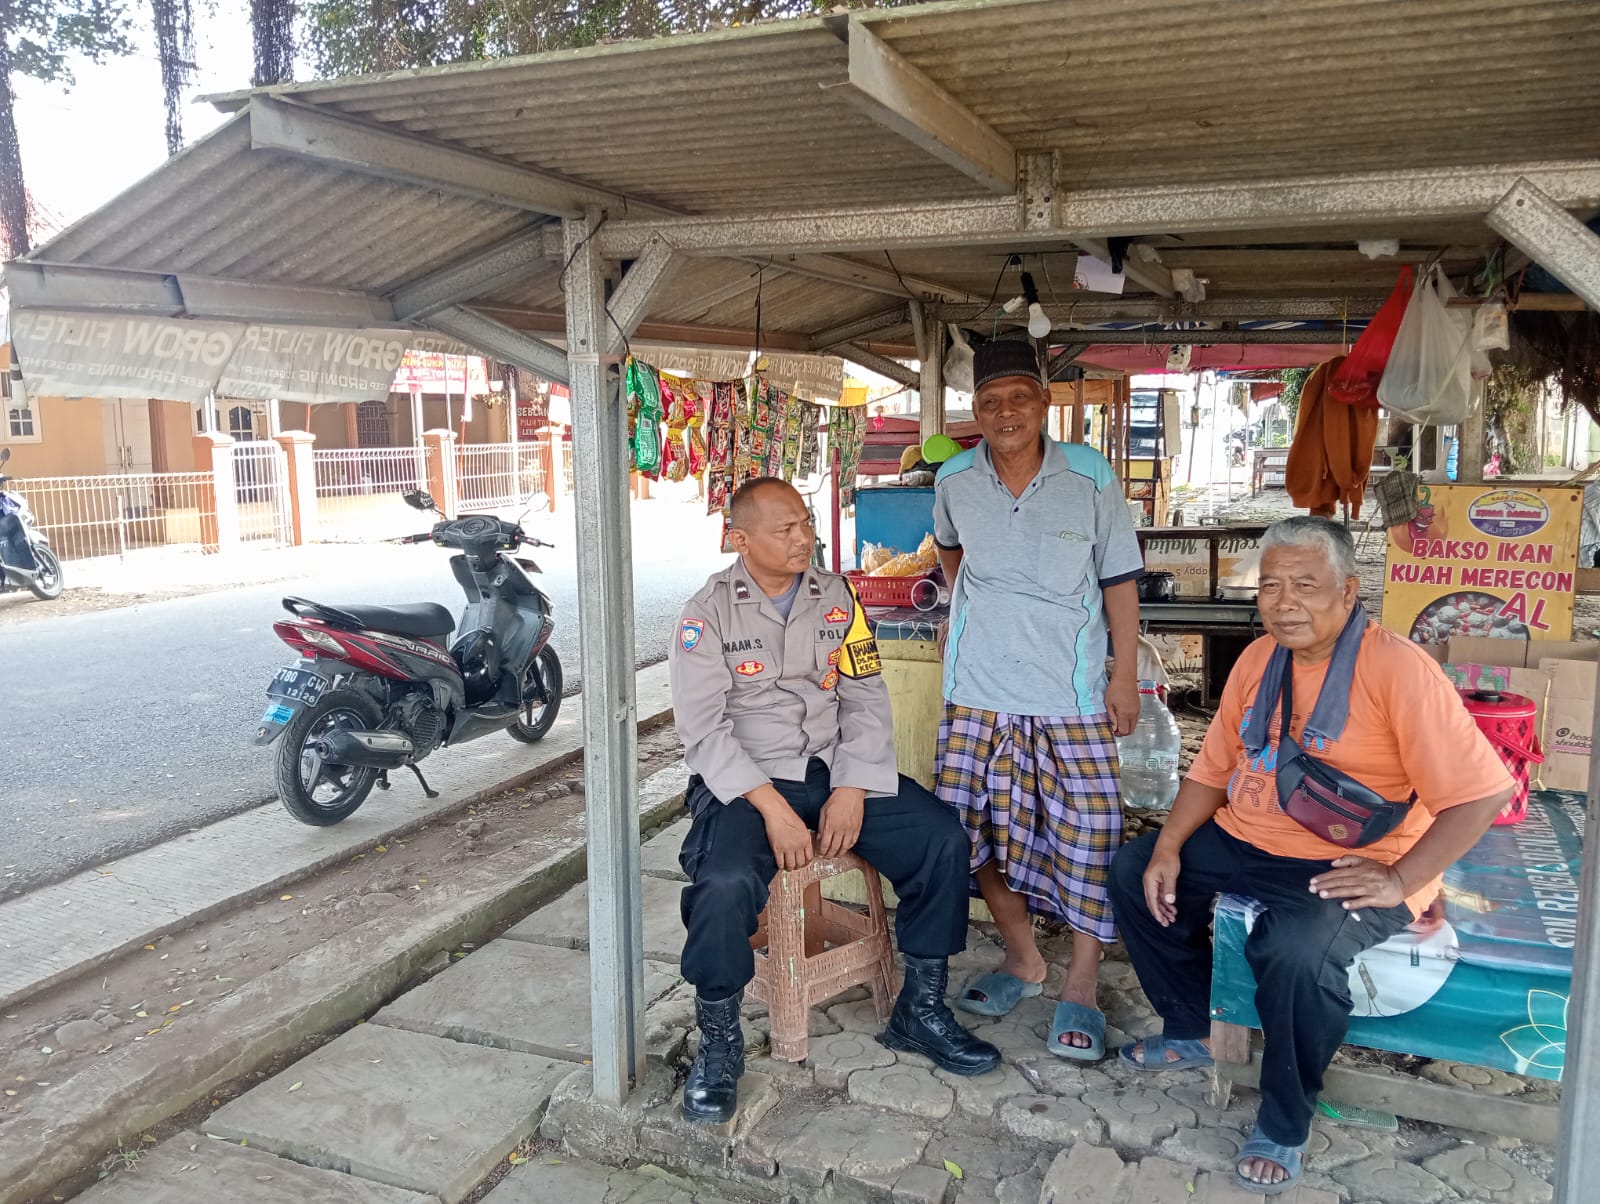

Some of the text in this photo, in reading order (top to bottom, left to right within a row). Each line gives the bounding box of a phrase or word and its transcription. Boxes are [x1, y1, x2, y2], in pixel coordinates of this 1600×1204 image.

[1412, 539, 1553, 564] BAKSO IKAN
[1390, 564, 1573, 592] KUAH MERECON
[1499, 592, 1551, 631] AL
